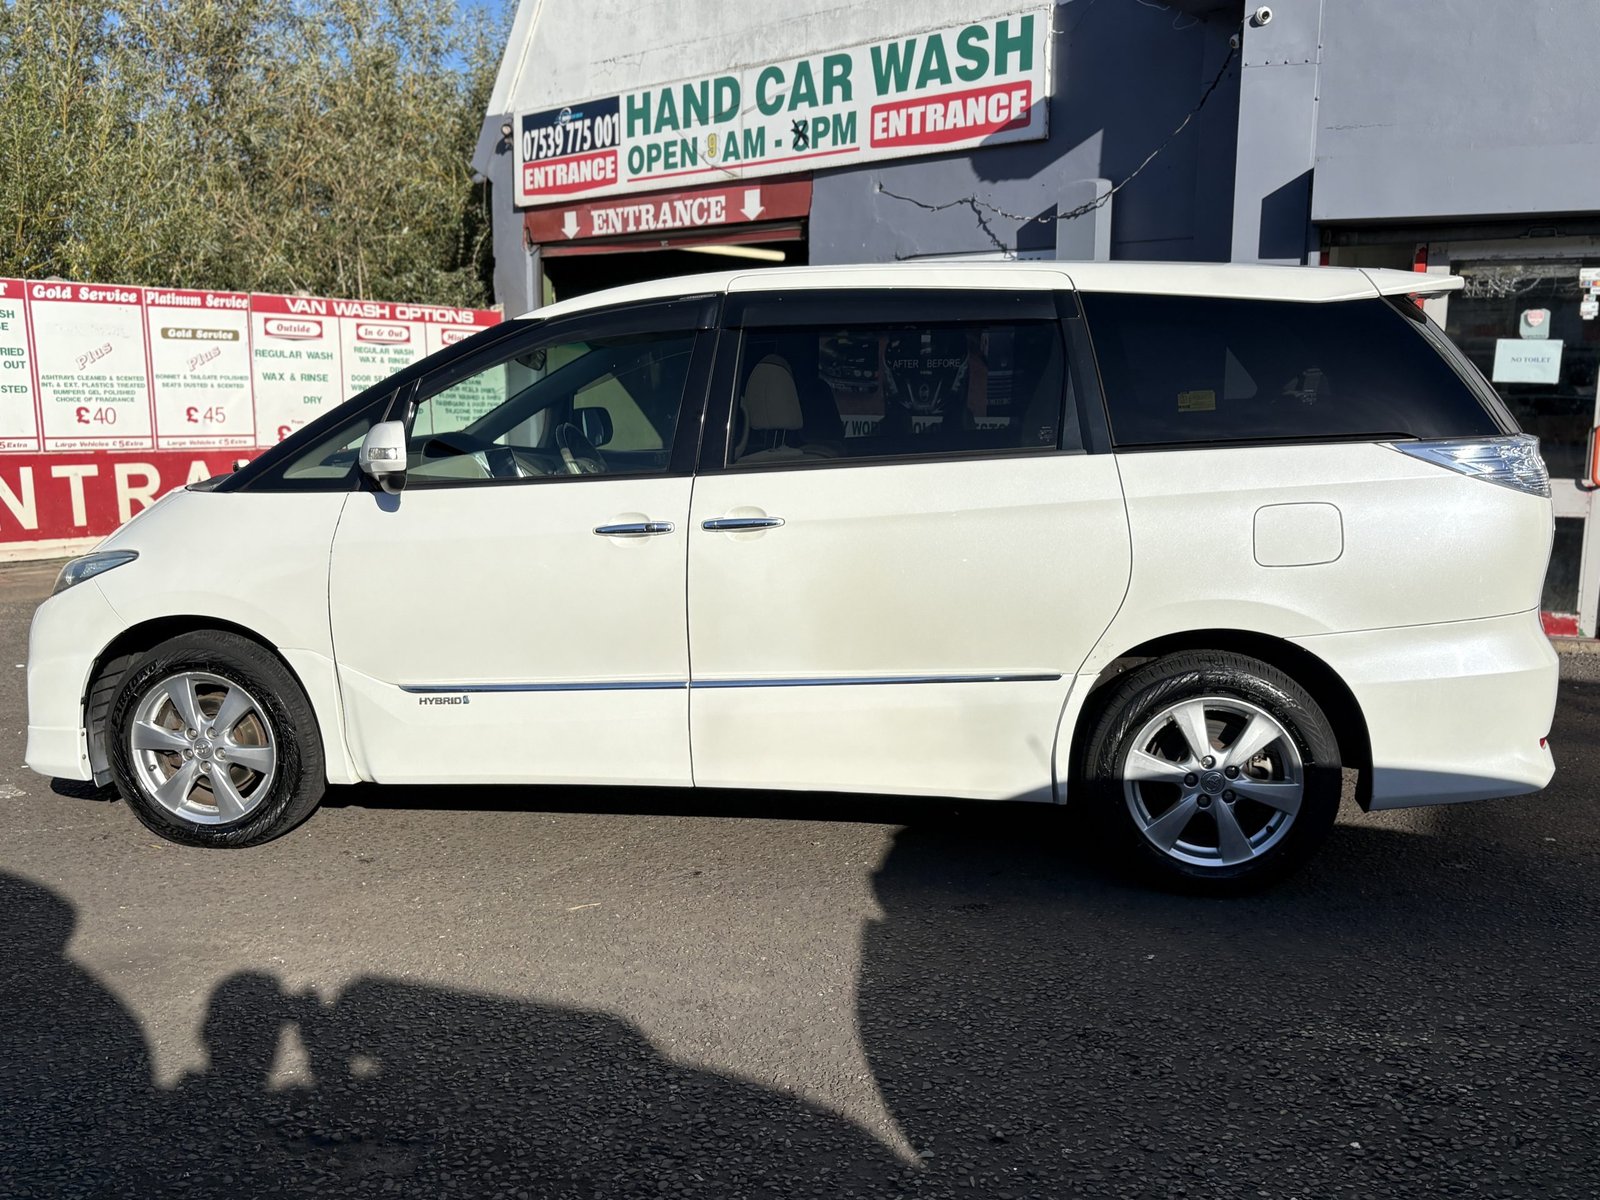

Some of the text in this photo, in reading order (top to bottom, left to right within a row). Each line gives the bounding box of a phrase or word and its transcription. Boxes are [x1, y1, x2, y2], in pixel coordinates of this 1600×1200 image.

[626, 14, 1035, 139] HAND CAR WASH
[873, 89, 1028, 141] ENTRANCE
[523, 112, 620, 162] 07539 775 001
[627, 136, 698, 176] OPEN
[524, 156, 616, 190] ENTRANCE
[591, 195, 727, 236] ENTRANCE
[32, 284, 138, 303] Gold Service
[145, 291, 248, 309] Platinum Service
[0, 309, 15, 319] SH
[285, 298, 474, 324] VAN WASH OPTIONS
[0, 322, 9, 331] E
[276, 323, 311, 333] Outside
[167, 328, 234, 340] Gold Service
[364, 328, 373, 336] In
[388, 329, 403, 337] Out
[75, 342, 113, 371] Plus
[254, 349, 333, 360] REGULAR WASH
[353, 346, 414, 356] REGULAR WASH
[3, 360, 26, 369] OUT
[186, 346, 221, 372] Plus
[388, 357, 410, 365] RINSE
[892, 358, 961, 369] AFTER BEFORE
[262, 372, 329, 382] WAX & RINSE
[1, 385, 28, 394] STED
[303, 396, 322, 404] DRY
[419, 696, 462, 705] HYBRID
